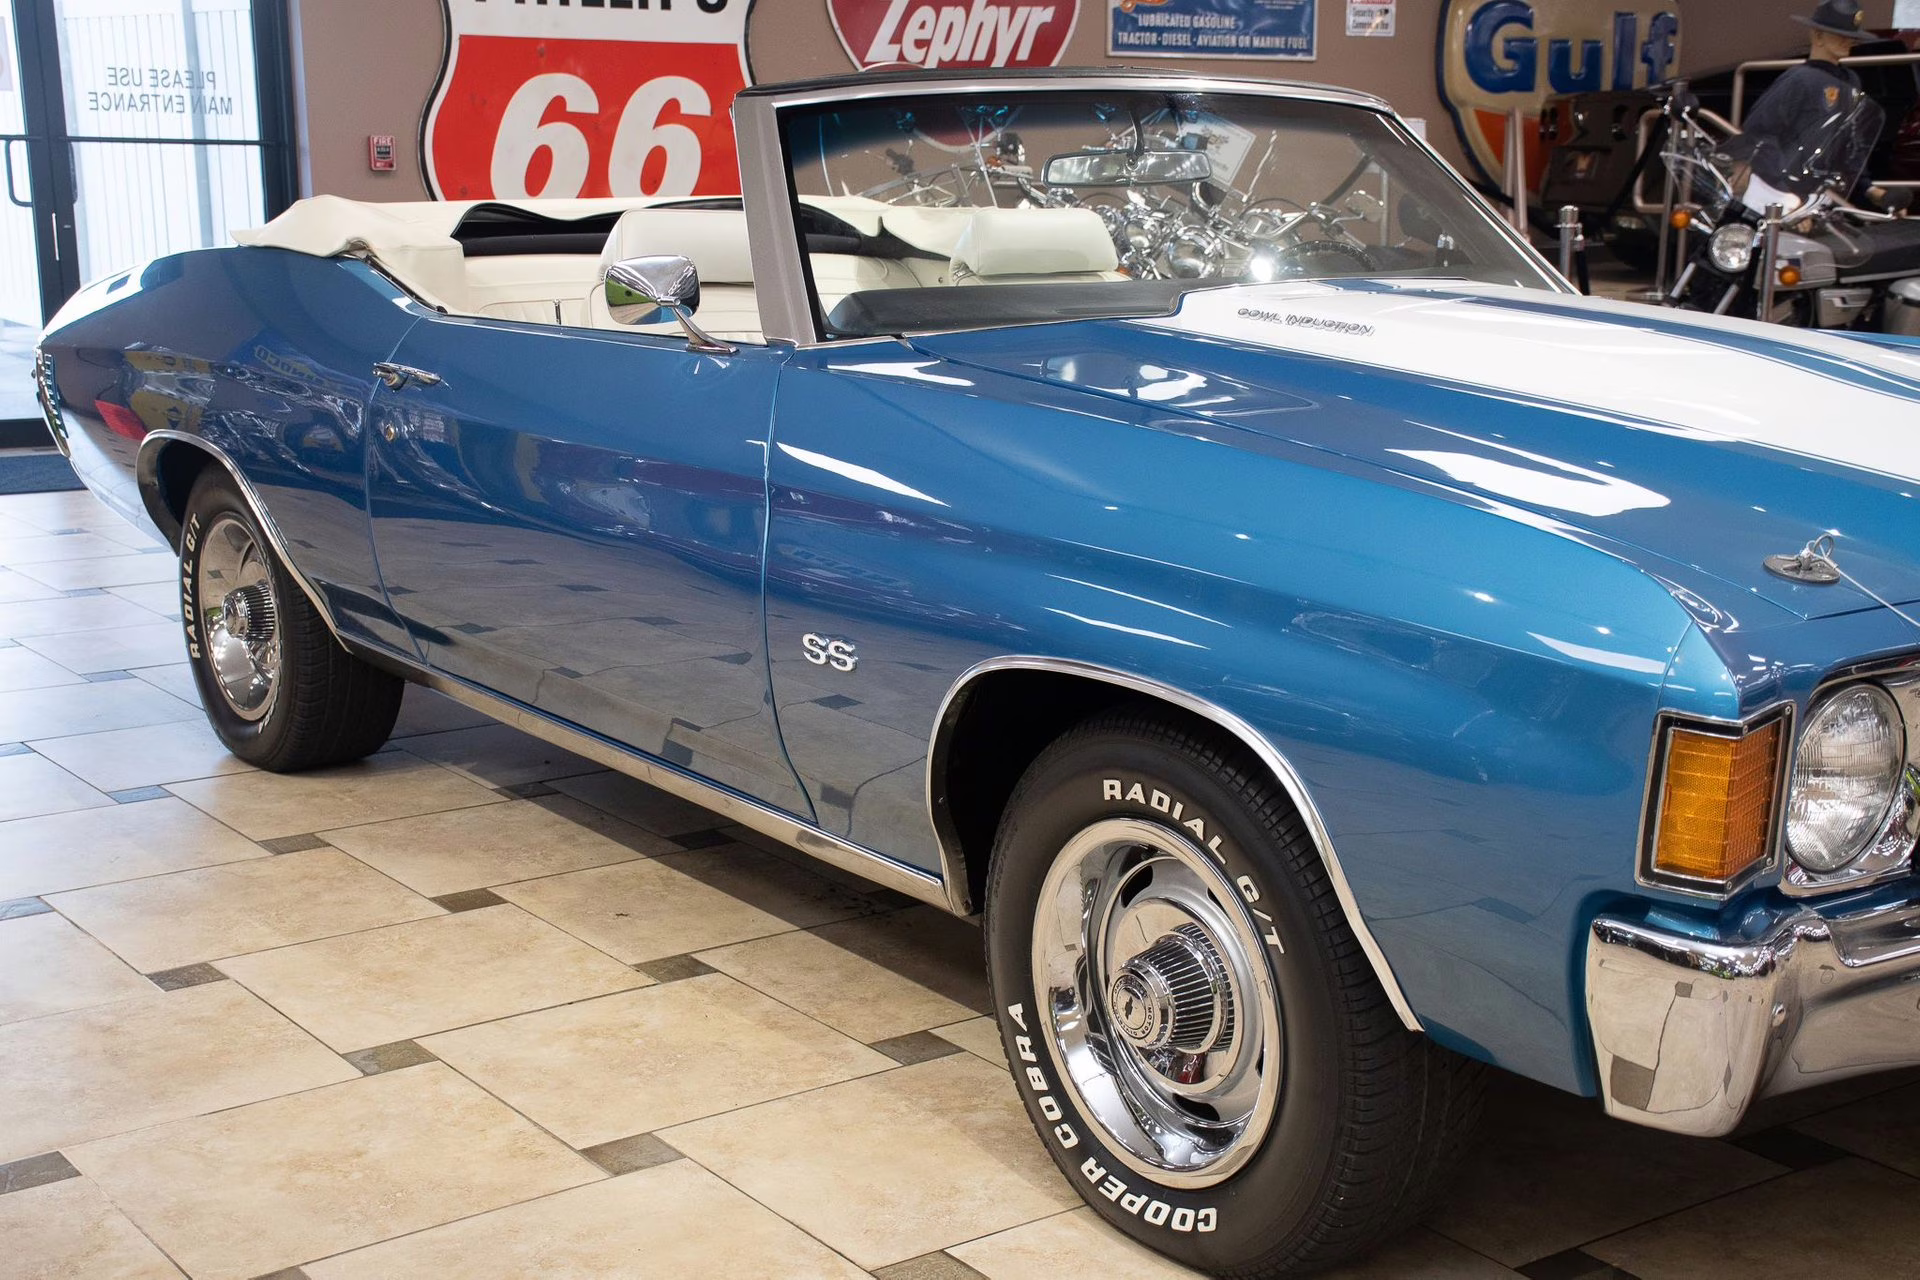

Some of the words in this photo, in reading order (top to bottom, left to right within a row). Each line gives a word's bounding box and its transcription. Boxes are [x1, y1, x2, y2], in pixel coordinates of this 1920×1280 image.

[864, 0, 1056, 68] Zephyr
[1118, 31, 1157, 45] TRACTOR
[1162, 33, 1192, 47] DIESEL
[1197, 34, 1237, 48] AVIATION
[1238, 35, 1251, 48] OR
[1252, 36, 1286, 49] MARINE
[1287, 37, 1308, 50] FUEL
[1138, 12, 1191, 28] LUBRICATED
[1193, 14, 1236, 29] GASOLINE
[1465, 0, 1681, 93] Gulf
[490, 72, 712, 200] 66
[185, 512, 201, 553] G/T
[183, 558, 201, 660] RADIAL
[802, 632, 859, 672] SS
[1102, 778, 1228, 866] RADIAL
[1236, 874, 1286, 956] G/T
[1007, 1002, 1081, 1150] COBRA
[1079, 1155, 1218, 1234] COOPER
